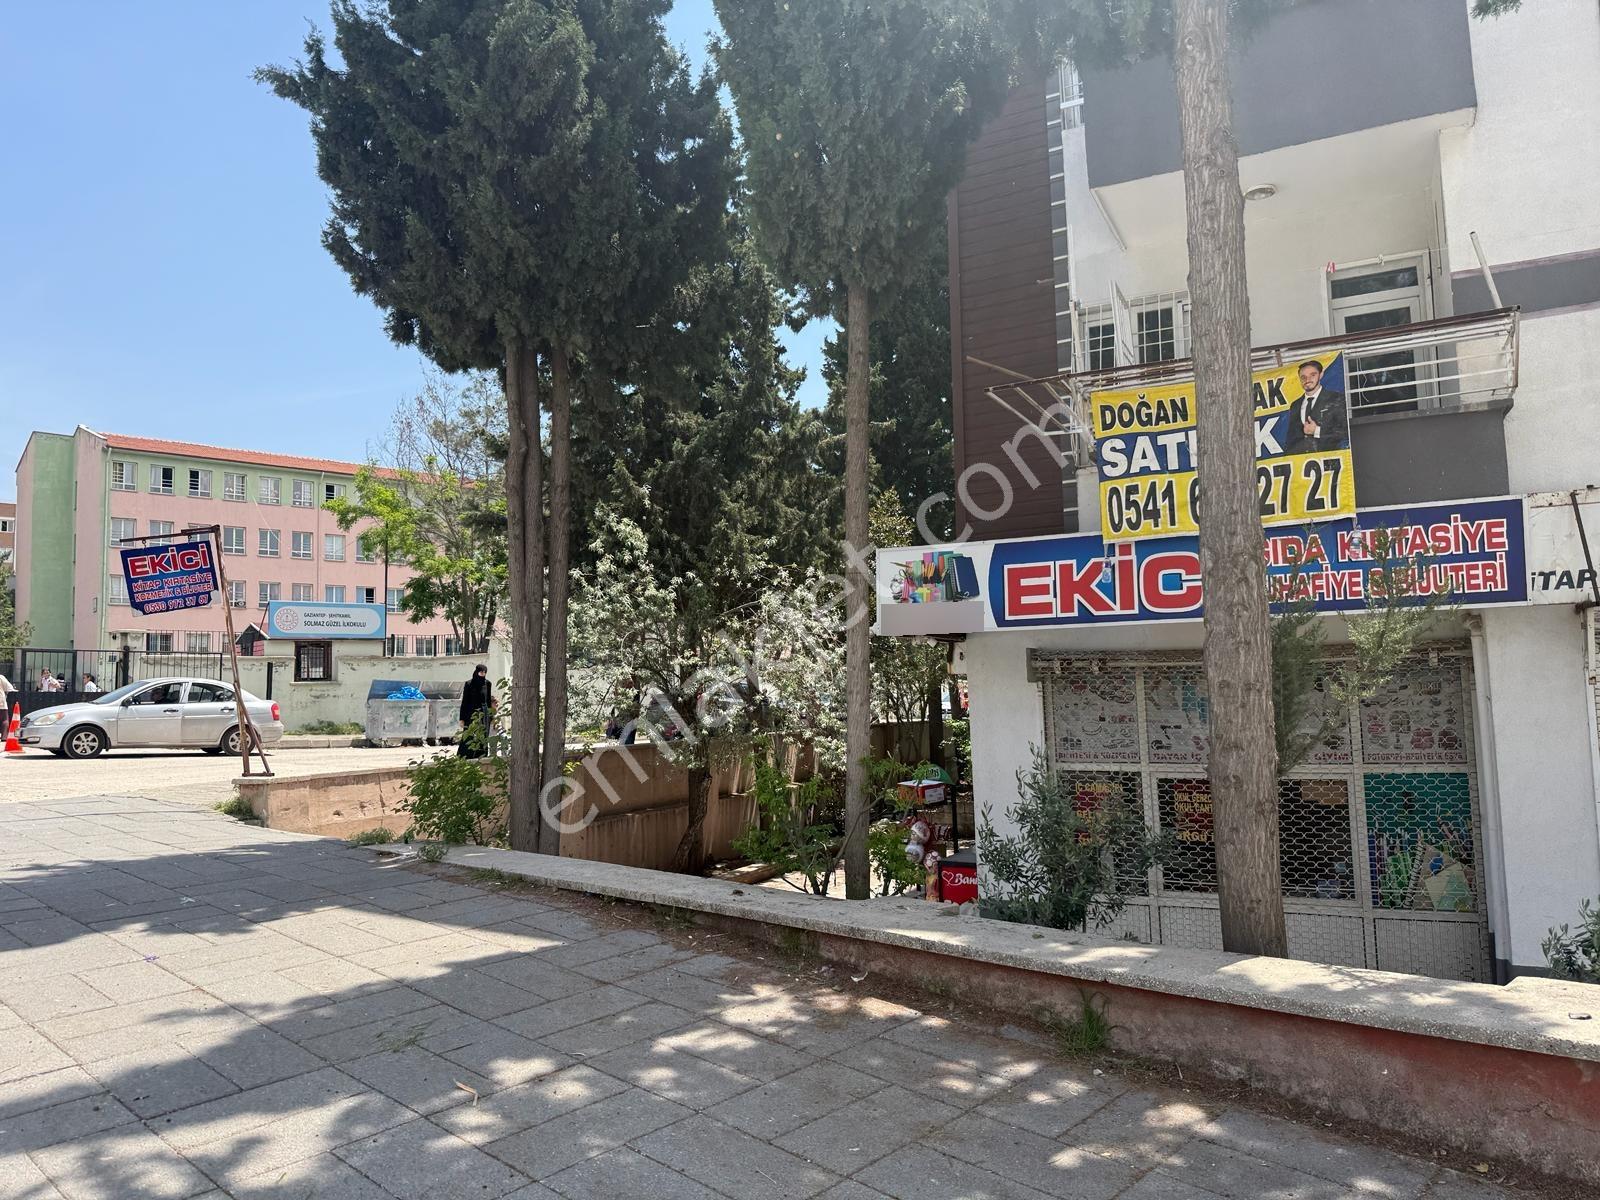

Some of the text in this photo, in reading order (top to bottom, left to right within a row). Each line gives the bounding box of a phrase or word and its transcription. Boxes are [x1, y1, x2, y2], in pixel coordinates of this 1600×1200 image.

[1099, 392, 1189, 432] DOĞAN
[1101, 416, 1284, 478] SATIK
[1107, 480, 1178, 534] 0541
[1258, 463, 1292, 516] 27
[1303, 457, 1343, 512] 27
[128, 544, 210, 578] EKİCİ
[132, 572, 213, 592] KİTAP KIRTASİYE
[134, 587, 175, 602] KOZMETİK
[1004, 541, 1204, 621] EKİC
[1265, 565, 1365, 603] UHAFİYE
[144, 601, 167, 614] 0530
[168, 599, 185, 611] 972
[325, 620, 342, 628] GÜZEL
[342, 620, 367, 628] İLKOKULU
